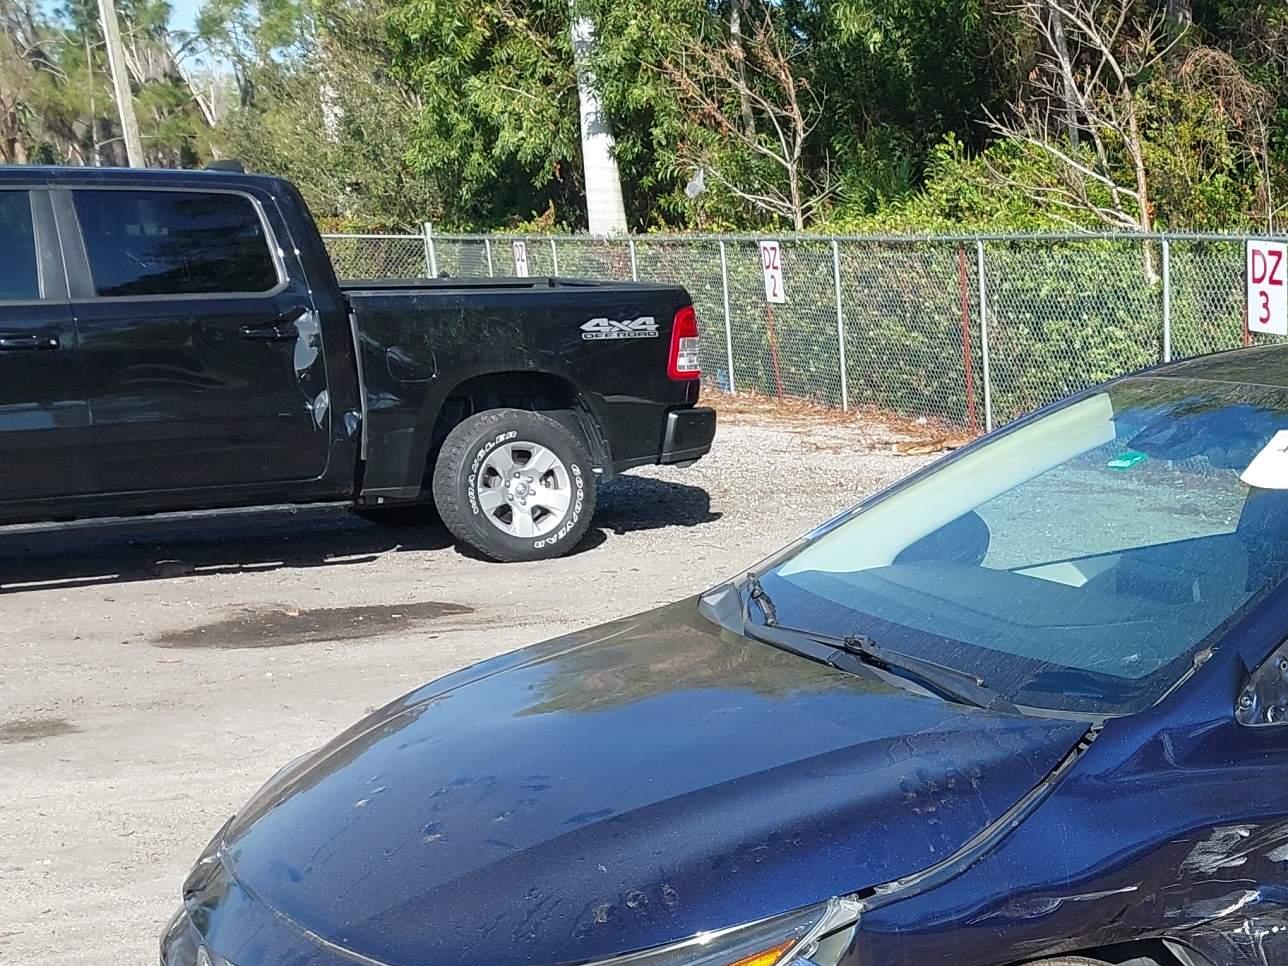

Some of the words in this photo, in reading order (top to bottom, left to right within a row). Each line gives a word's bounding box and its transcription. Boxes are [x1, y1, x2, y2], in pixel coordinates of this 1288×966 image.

[762, 246, 779, 270] DZ
[1251, 248, 1284, 286] DZ
[770, 274, 778, 297] 2
[1259, 290, 1271, 324] 3
[467, 430, 518, 515] WRANGLER
[533, 463, 585, 549] GOODYEAR
